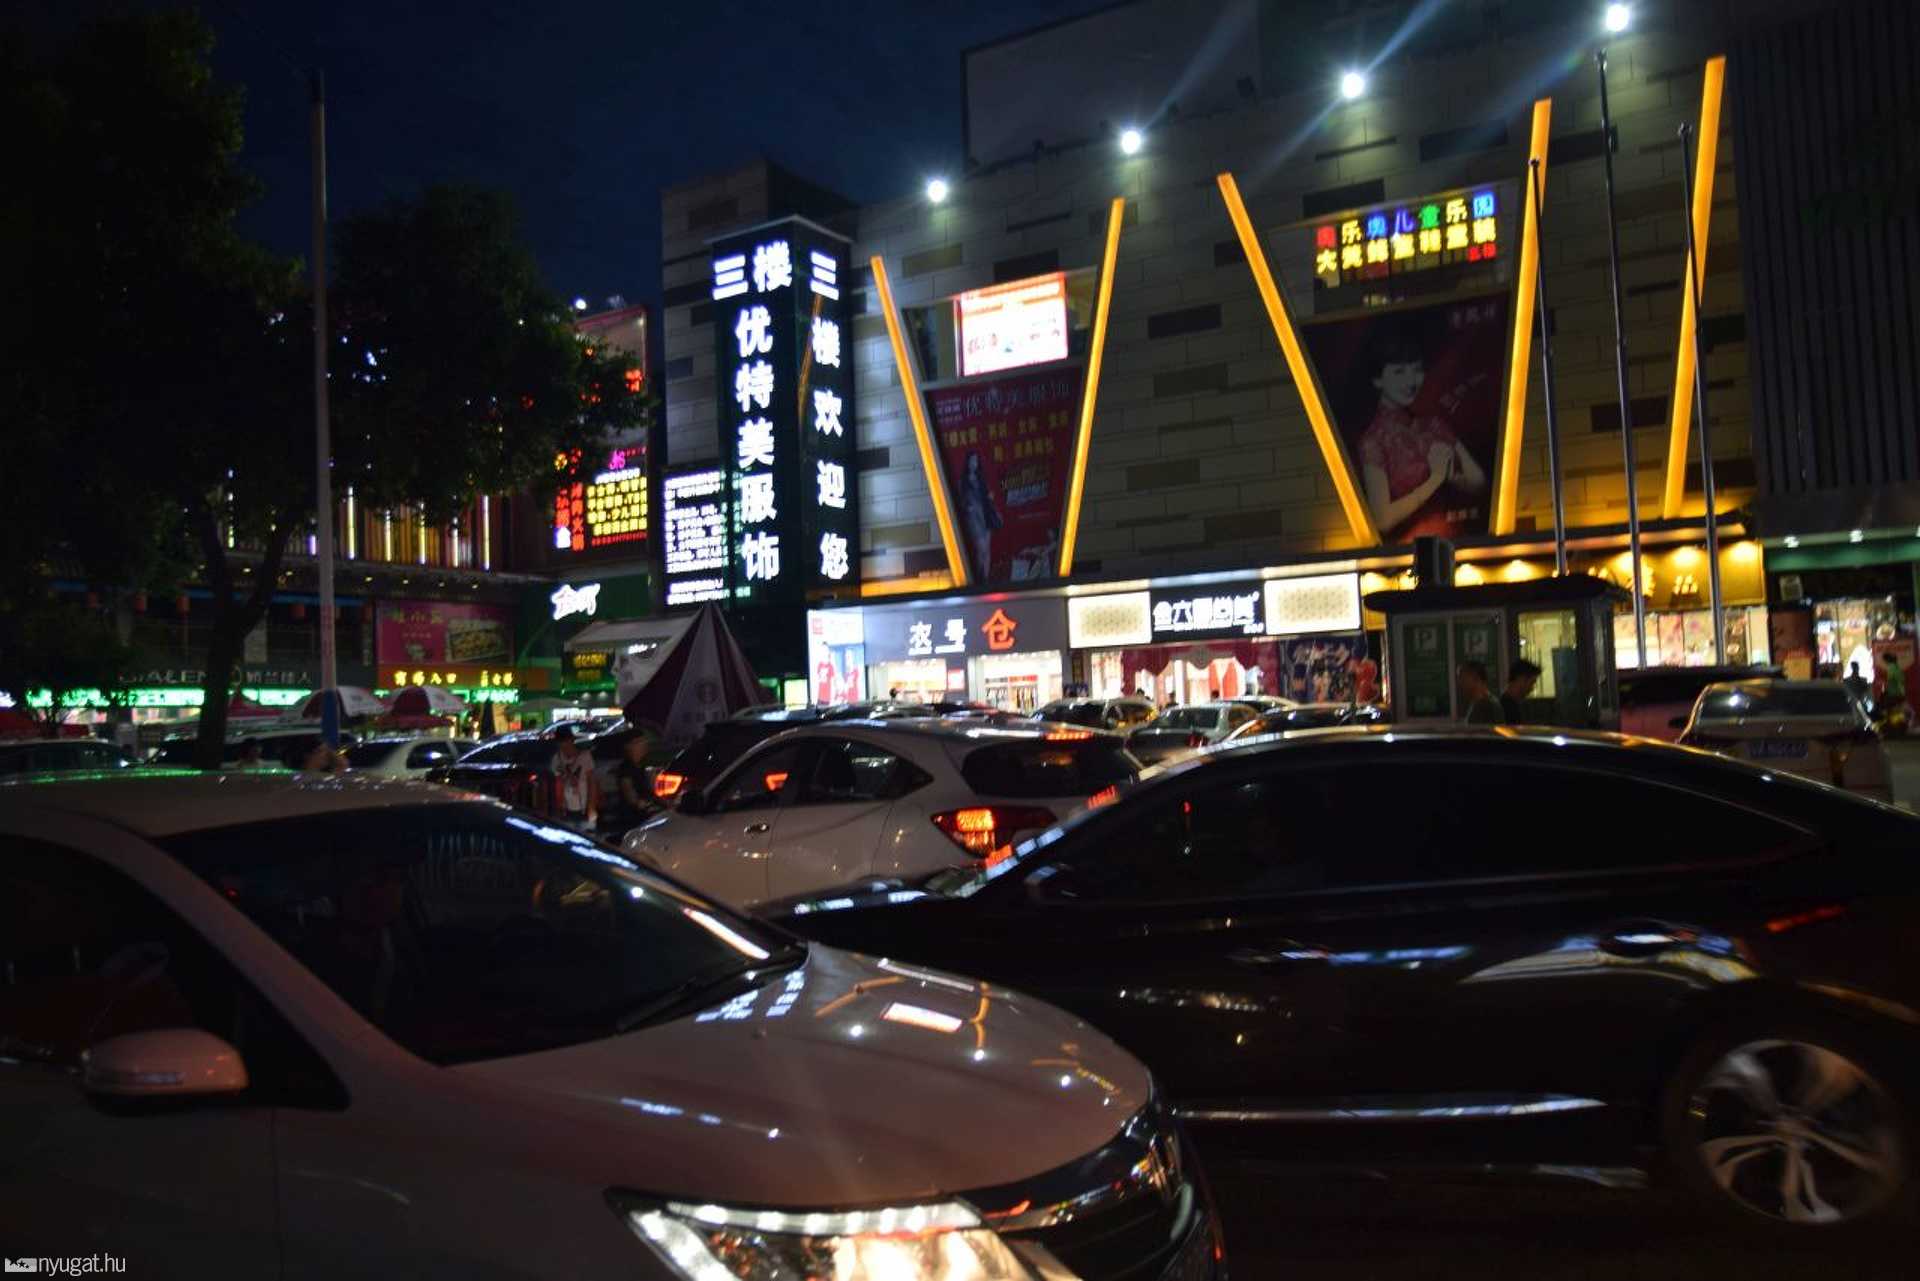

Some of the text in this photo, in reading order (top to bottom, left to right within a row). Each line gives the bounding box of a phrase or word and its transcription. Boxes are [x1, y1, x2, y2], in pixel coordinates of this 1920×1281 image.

[713, 241, 793, 300] 三楼
[735, 304, 780, 582] 优特美服饰
[810, 250, 850, 581] 三楼欢迎您
